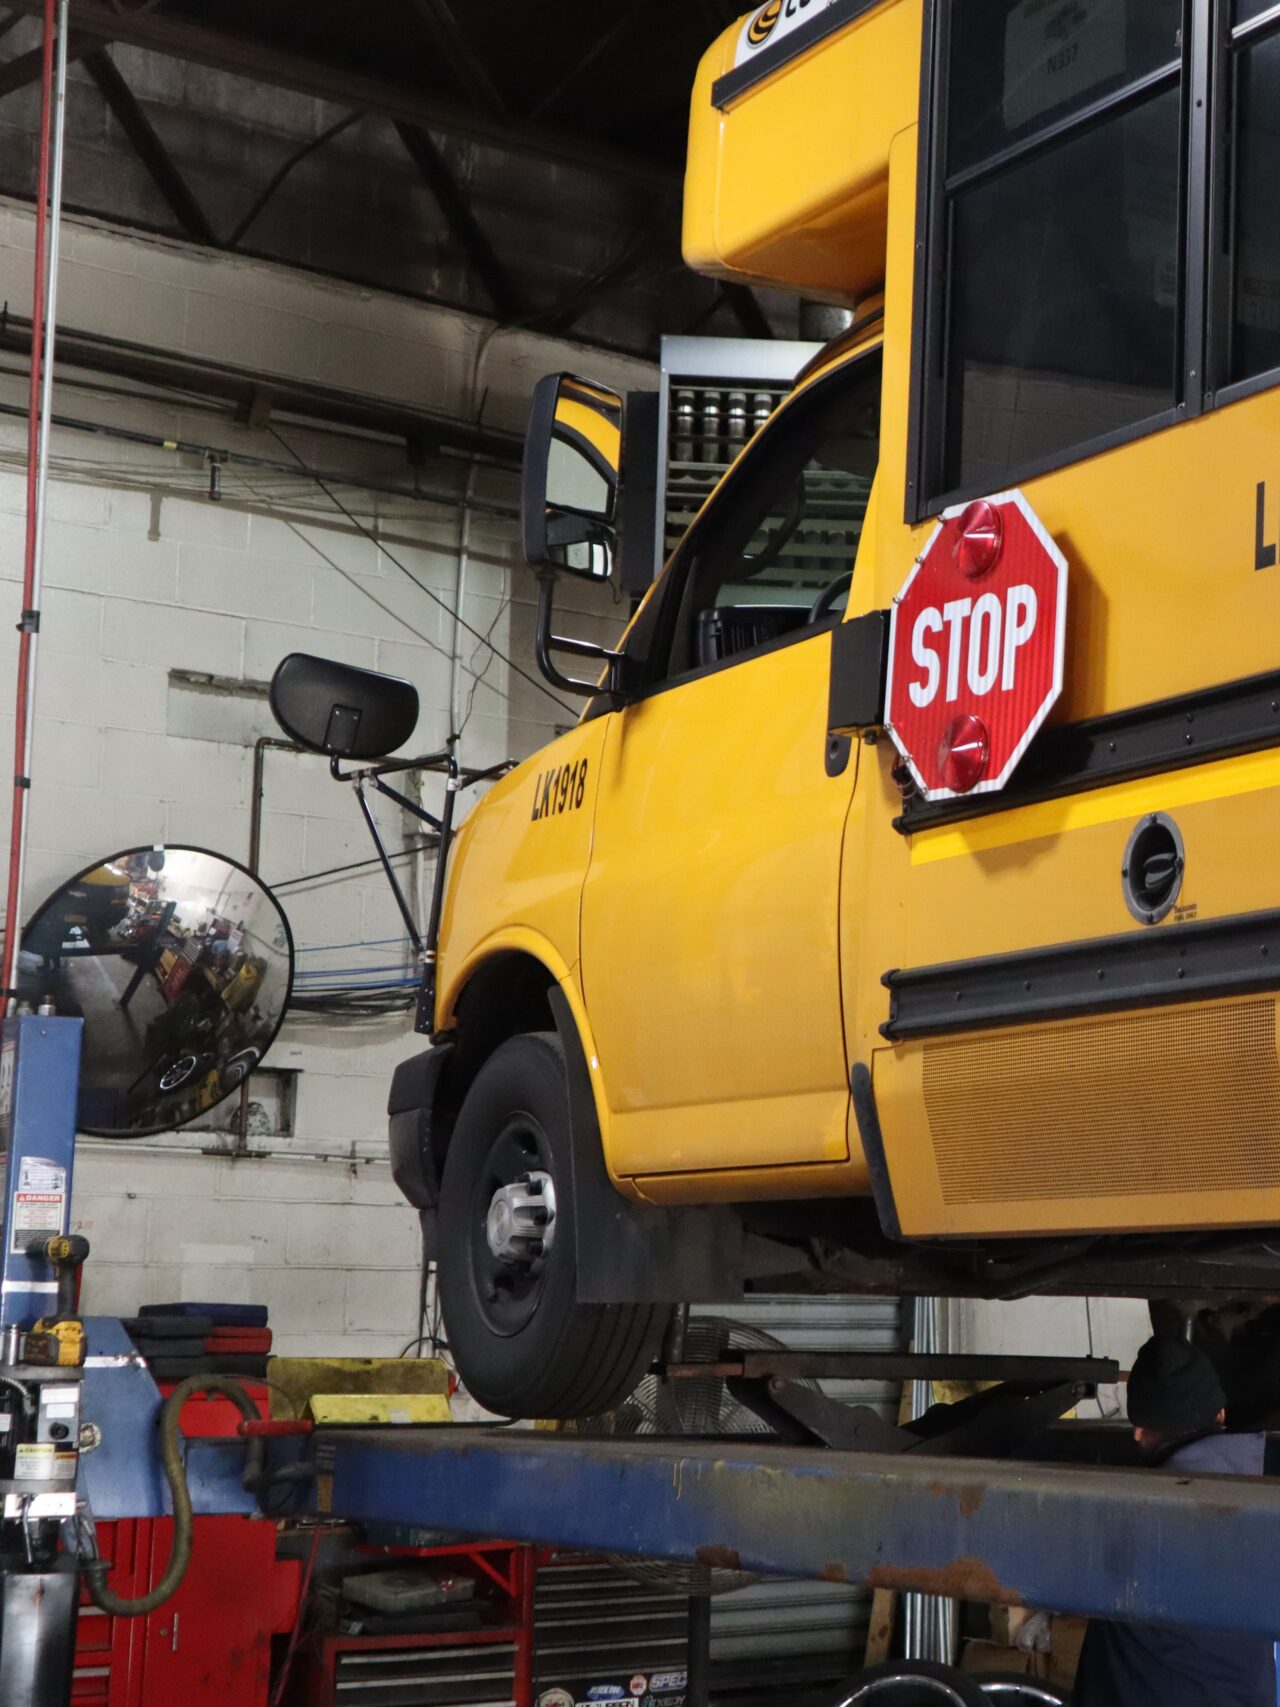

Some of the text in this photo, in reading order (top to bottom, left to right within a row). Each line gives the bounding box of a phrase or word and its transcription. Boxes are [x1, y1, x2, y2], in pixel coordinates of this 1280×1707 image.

[908, 583, 1038, 709] STOP
[531, 757, 588, 822] LK1918
[25, 1194, 61, 1202] DANGER
[651, 1671, 688, 1689] SPEC
